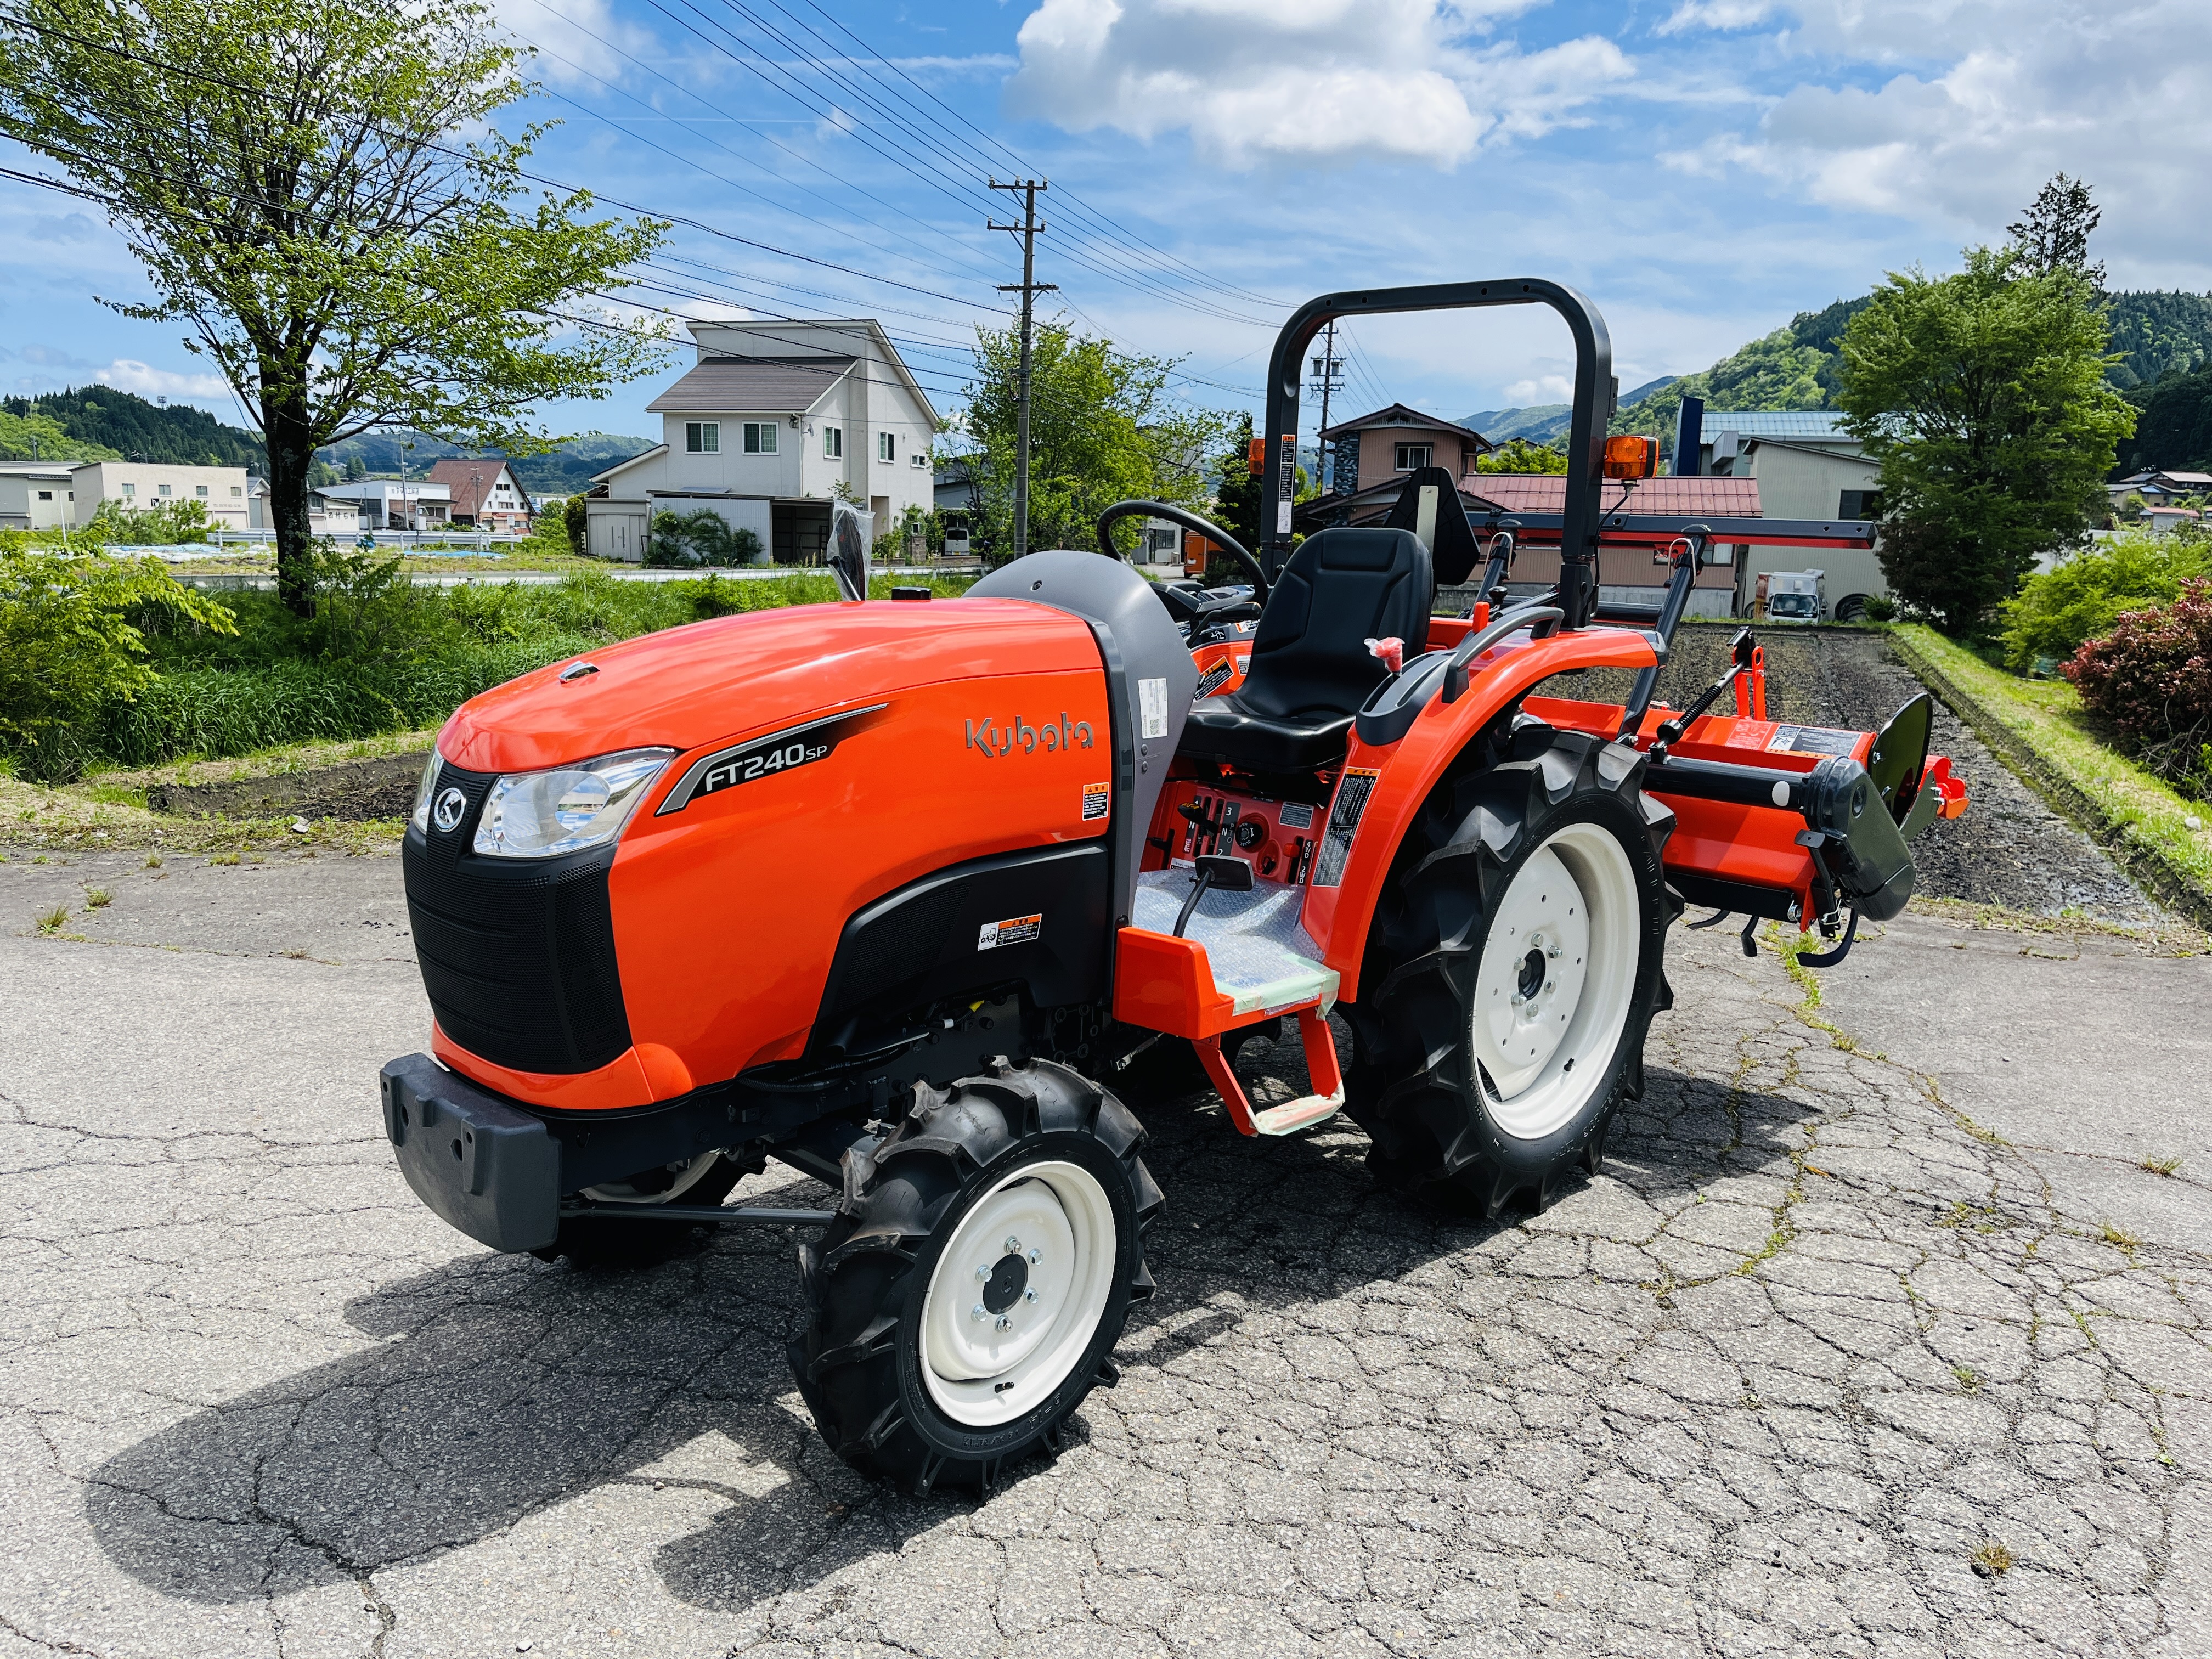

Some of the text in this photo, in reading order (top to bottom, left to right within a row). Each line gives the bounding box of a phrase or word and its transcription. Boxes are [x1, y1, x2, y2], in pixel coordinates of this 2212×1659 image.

[965, 712, 1093, 758] Kubota
[1226, 806, 1232, 816] 3
[1189, 821, 1195, 830] N
[1221, 827, 1228, 836] N
